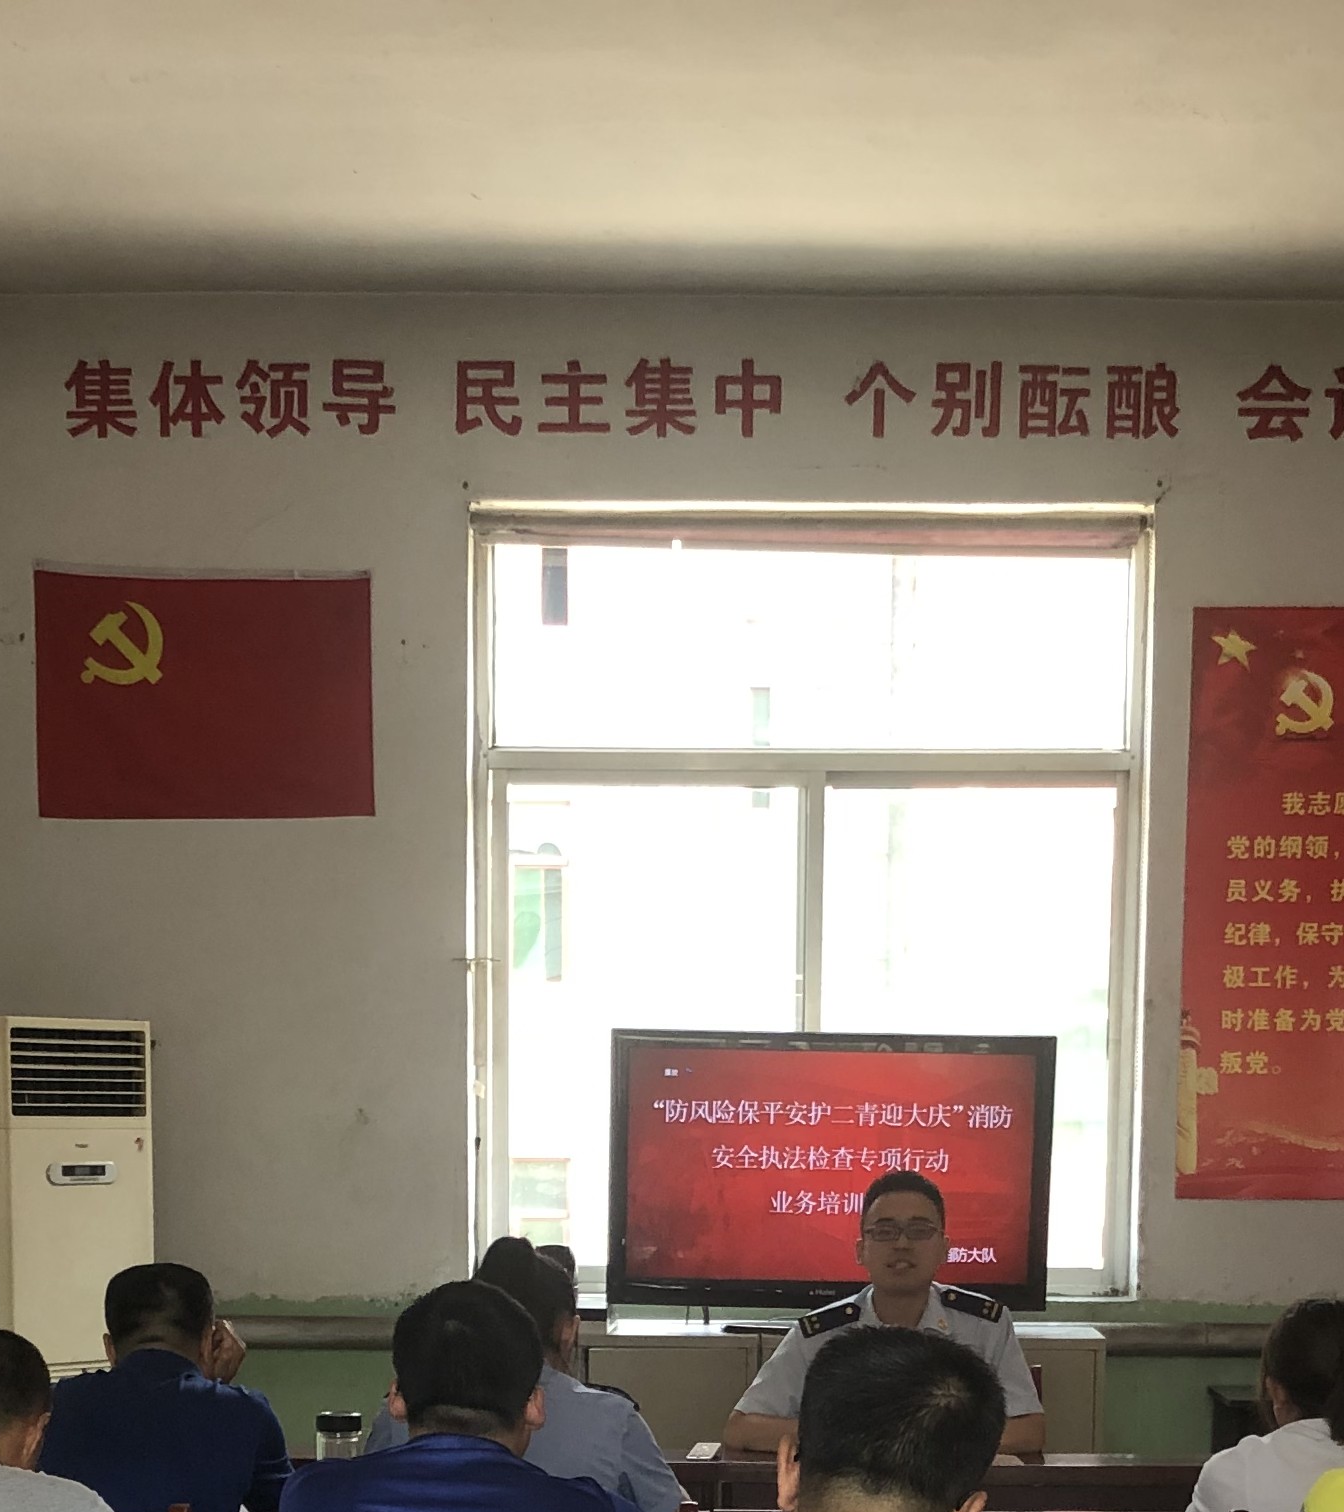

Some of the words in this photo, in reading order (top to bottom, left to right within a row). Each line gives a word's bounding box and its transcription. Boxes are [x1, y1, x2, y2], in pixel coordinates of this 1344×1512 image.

[64, 359, 398, 438] 集体领导
[454, 358, 785, 438] 民主集中
[844, 360, 1182, 440] 个别酝酿
[711, 1144, 949, 1173] 安全执法检查专项行动
[769, 1190, 864, 1215] 业务培训
